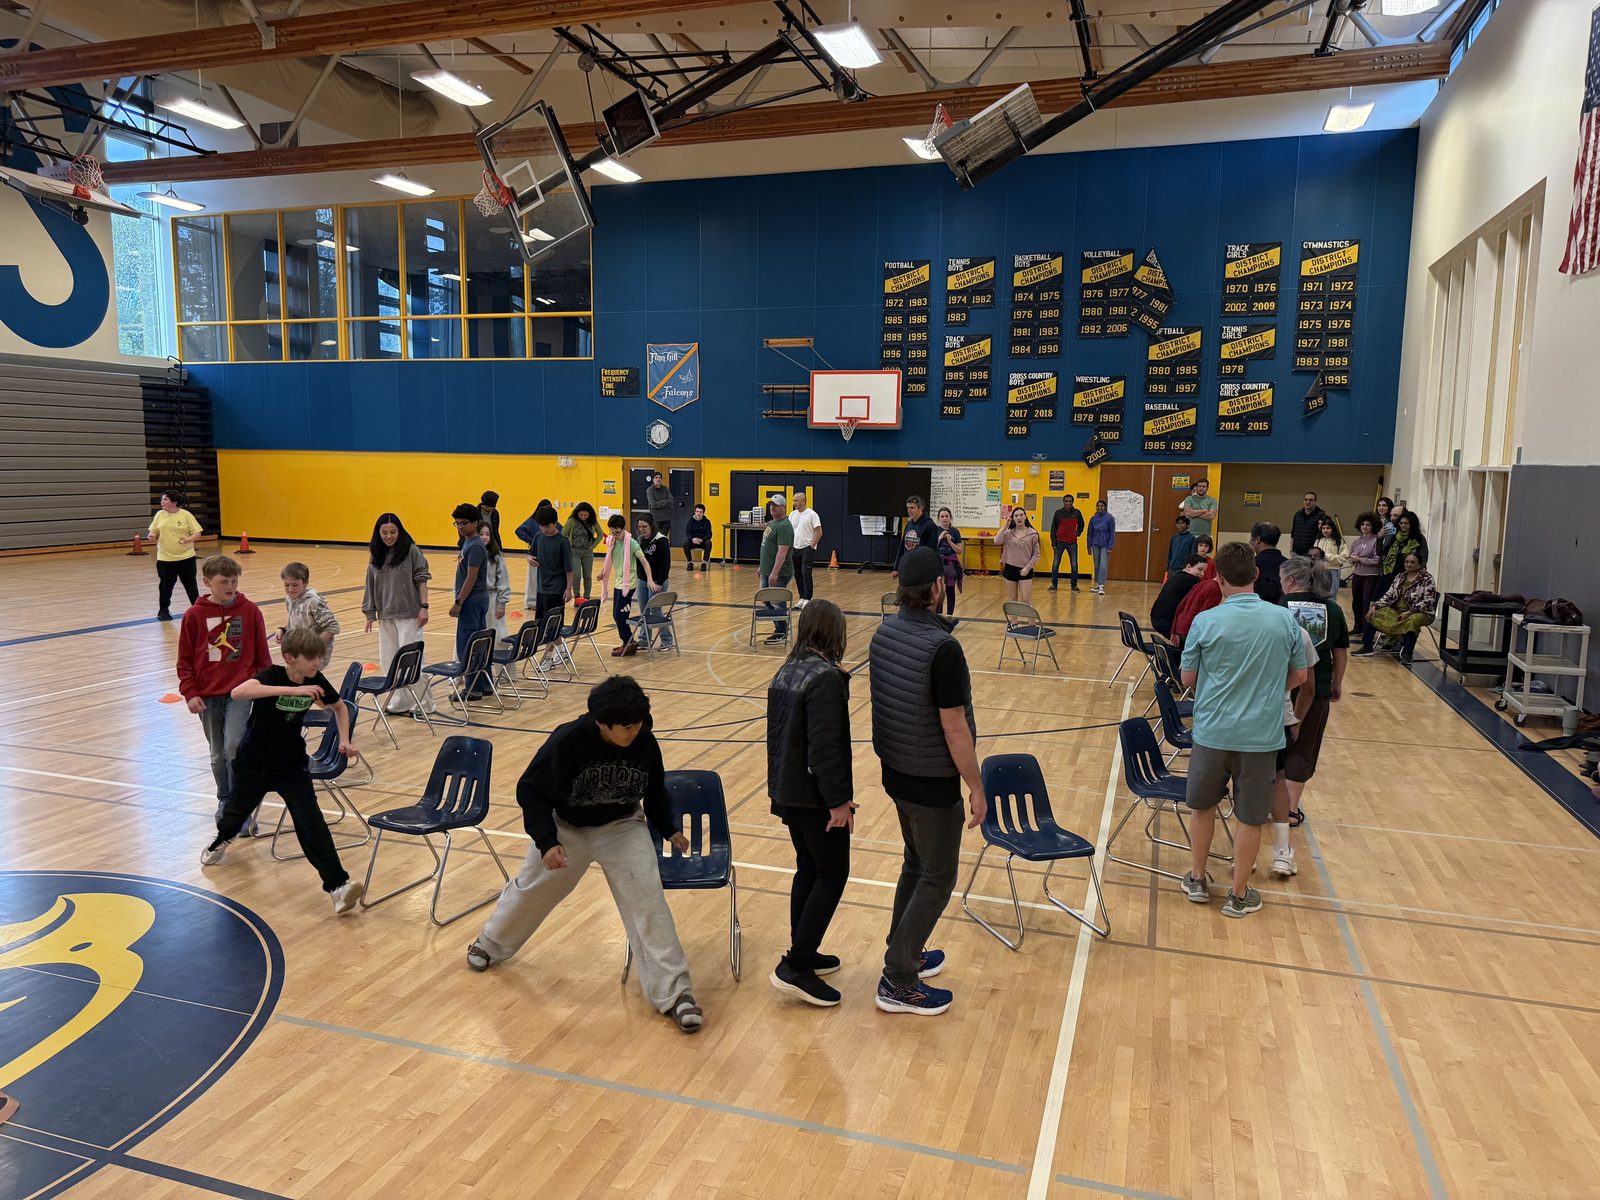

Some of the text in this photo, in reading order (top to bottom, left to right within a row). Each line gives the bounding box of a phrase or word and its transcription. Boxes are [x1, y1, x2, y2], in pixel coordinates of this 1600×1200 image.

[1227, 244, 1250, 252] TRACK
[1303, 241, 1350, 249] GYMNASTICS
[1014, 254, 1051, 262] BASKETBALL
[1083, 250, 1121, 258] VOLLEYBALL
[1226, 251, 1248, 259] GIRLS
[1311, 250, 1347, 266] DISTRICT
[1235, 252, 1269, 269] DISTRICT
[1309, 256, 1353, 275] CHAMPIONS
[948, 264, 963, 272] BOYS
[1022, 262, 1053, 278] DISTRICT
[1091, 259, 1122, 275] DISTRICT
[1232, 259, 1275, 277] CHAMPIONS
[892, 270, 920, 285] DISTRICT
[955, 266, 985, 282] DISTRICT
[1020, 268, 1058, 285] CHAMPIONS
[1089, 265, 1128, 282] CHAMPIONS
[891, 275, 926, 292] CHAMPIONS
[954, 272, 990, 289] CHAMPIONS
[1226, 283, 1276, 293] 1970 1976
[1303, 281, 1354, 291] 1971 1972
[1015, 291, 1060, 302] 1974 1975
[1083, 288, 1129, 298] 1976 1977
[885, 298, 928, 307] 1972 1983
[948, 295, 992, 304] 1974 1982
[1132, 286, 1148, 299] 977
[1149, 298, 1168, 313] 1981
[1225, 301, 1276, 312] 2002 2009
[1300, 300, 1352, 310] 1973 1974
[1013, 309, 1060, 319] 1976 1980
[1082, 307, 1103, 316] 1980
[1109, 306, 1127, 315] 1981
[885, 315, 927, 324] 1985 1986
[947, 313, 966, 322] 1983
[1139, 313, 1159, 330] 1995
[1081, 323, 1128, 334] 1992 2006
[1299, 319, 1351, 329] 1975 1976
[1013, 327, 1059, 337] 1981 1983
[884, 333, 927, 342] 1989 1995
[1230, 334, 1264, 350] DISTRICT
[945, 341, 960, 349] BOYS
[1158, 336, 1191, 351] DISTRICT
[1297, 338, 1348, 348] 1977 1981
[883, 350, 927, 358] 1996 1998
[953, 343, 982, 358] DISTRICT
[1011, 345, 1058, 354] 1984 1990
[1156, 342, 1196, 359] CHAMPIONS
[1228, 340, 1270, 358] CHAMPIONS
[951, 349, 987, 366] CHAMPIONS
[1296, 357, 1348, 366] 1983 1989
[908, 367, 926, 375] 2001
[1148, 365, 1198, 375] 1980 1985
[1221, 365, 1244, 374] 1978
[945, 371, 988, 380] 1985 1996
[1324, 375, 1348, 384] 1995
[663, 386, 694, 399] Falcons
[907, 384, 926, 392] 2006
[944, 388, 987, 398] 1997 2014
[1017, 381, 1047, 395] DISTRICT
[1082, 385, 1114, 399] DISTRICT
[1148, 384, 1197, 393] 1991 1997
[1220, 389, 1239, 397] GIRLS
[1015, 387, 1052, 403] CHAMPIONS
[1080, 391, 1119, 406] CHAMPIONS
[1228, 393, 1261, 407] DISTRICT
[943, 406, 961, 414] 2015
[1145, 403, 1179, 411] BASEBALL
[1226, 399, 1267, 415] CHAMPIONS
[1009, 409, 1053, 418] 2017 2018
[1073, 413, 1120, 422] 1978 1980
[1153, 413, 1185, 427] DISTRICT
[1008, 426, 1027, 435] 2019
[1151, 419, 1191, 435] CHAMPIONS
[1220, 422, 1269, 431] 2014 2015
[1144, 441, 1193, 450] 1985 1992
[1086, 447, 1107, 464] 2002
